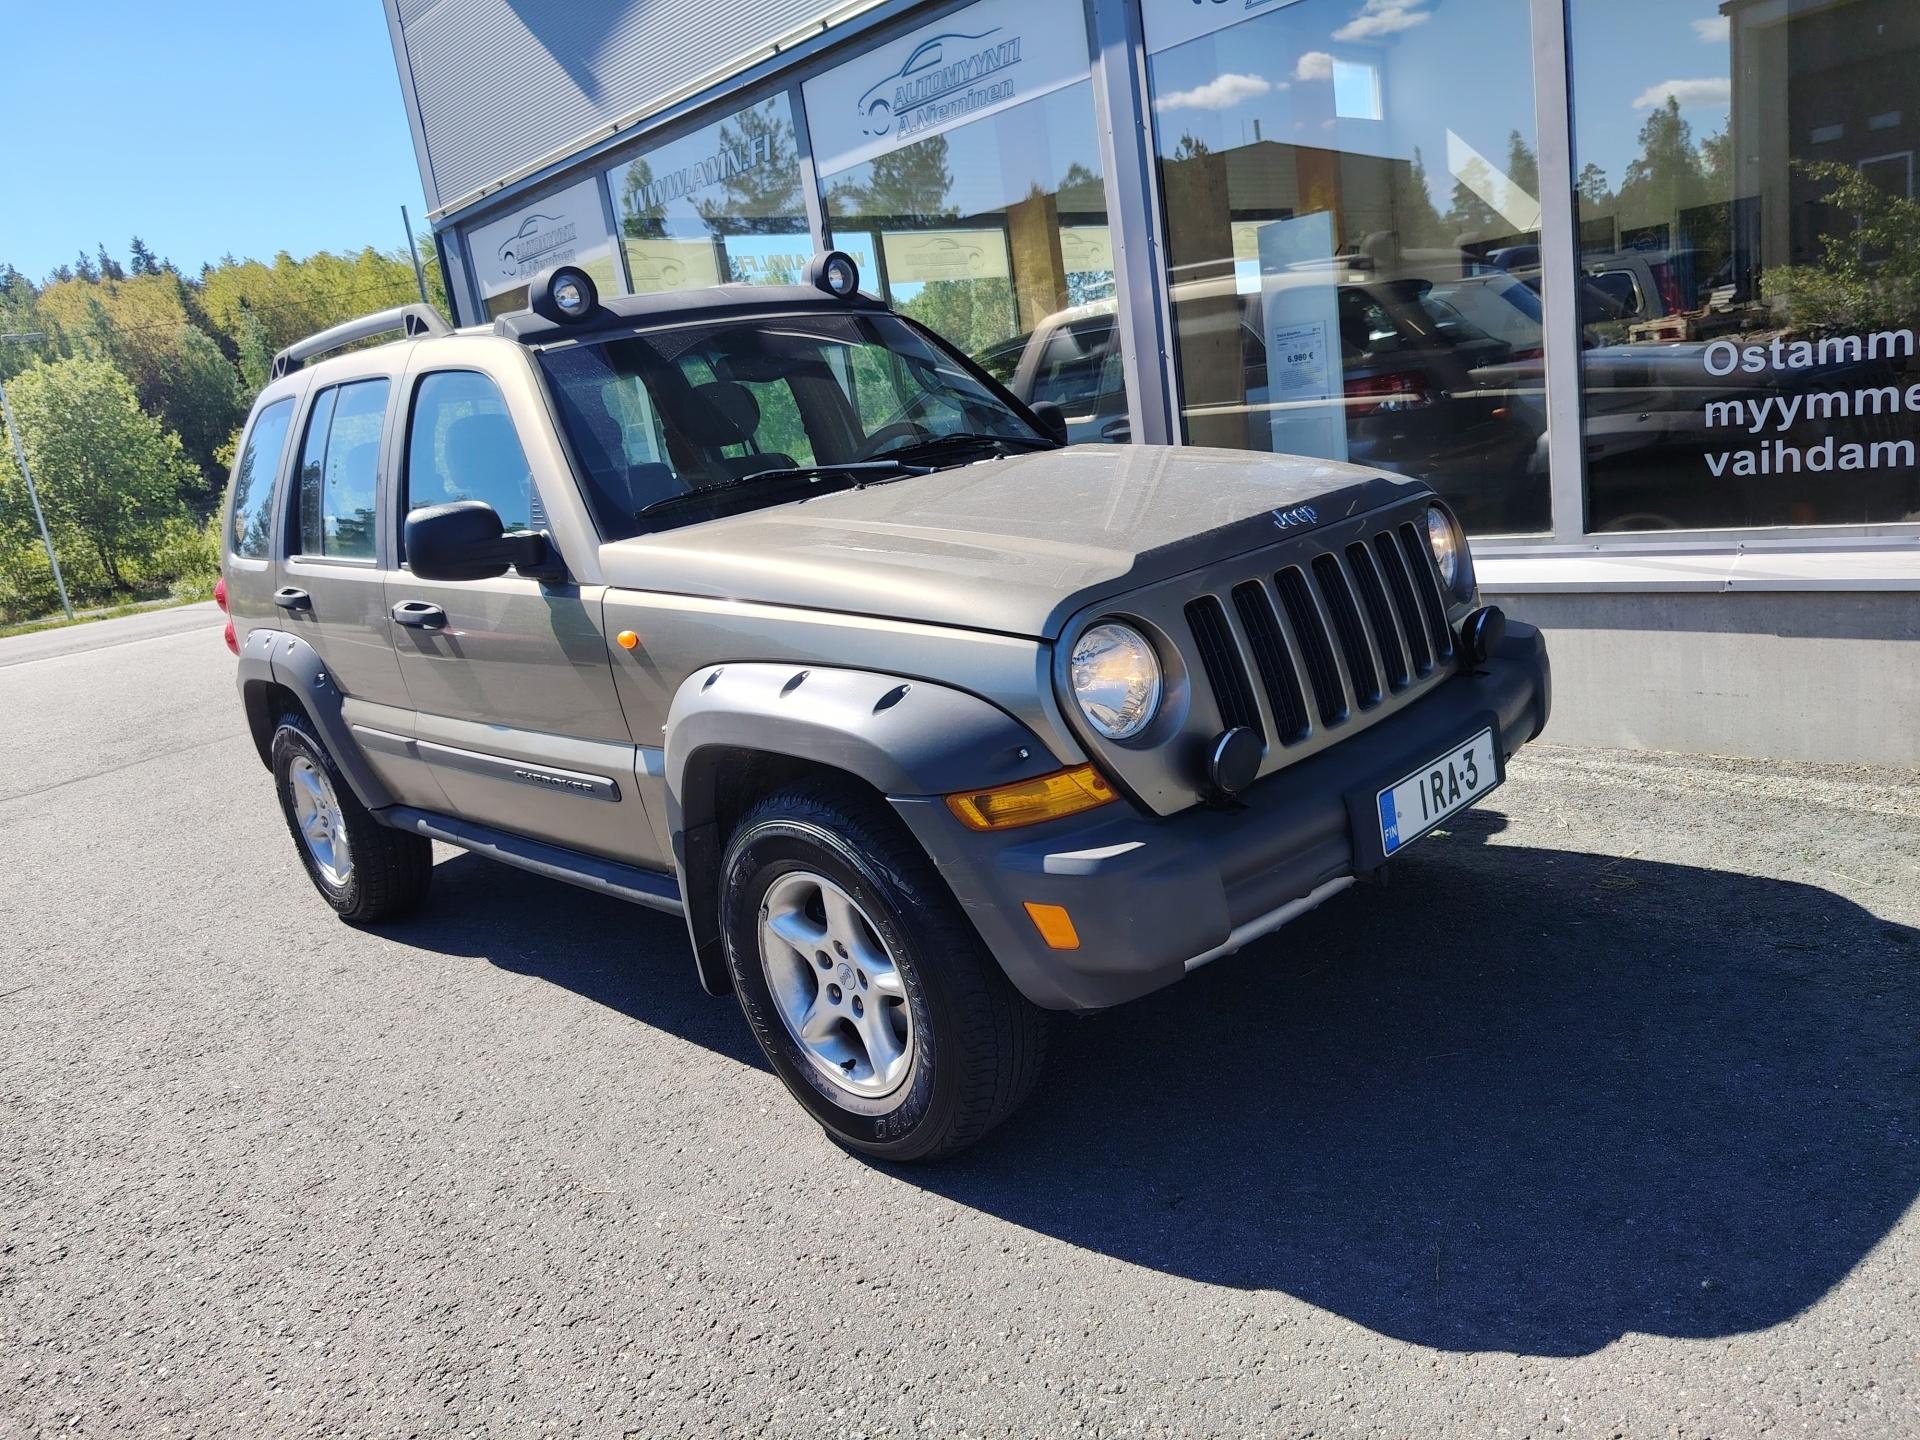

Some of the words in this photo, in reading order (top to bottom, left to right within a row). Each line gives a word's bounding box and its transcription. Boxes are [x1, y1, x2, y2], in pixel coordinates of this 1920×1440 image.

[893, 36, 1021, 110] AUTOMYYNTI
[897, 78, 1016, 141] A.Nieminen
[629, 133, 772, 217] WWW.AMN.FI
[1703, 328, 1920, 377] Ostamm
[1704, 384, 1920, 434] myymme
[1703, 436, 1915, 477] vaihdam
[1271, 505, 1318, 530] Jeep
[514, 770, 593, 792] CHEROKEE
[1419, 748, 1478, 821] IRA-3
[1384, 824, 1398, 841] FIN
